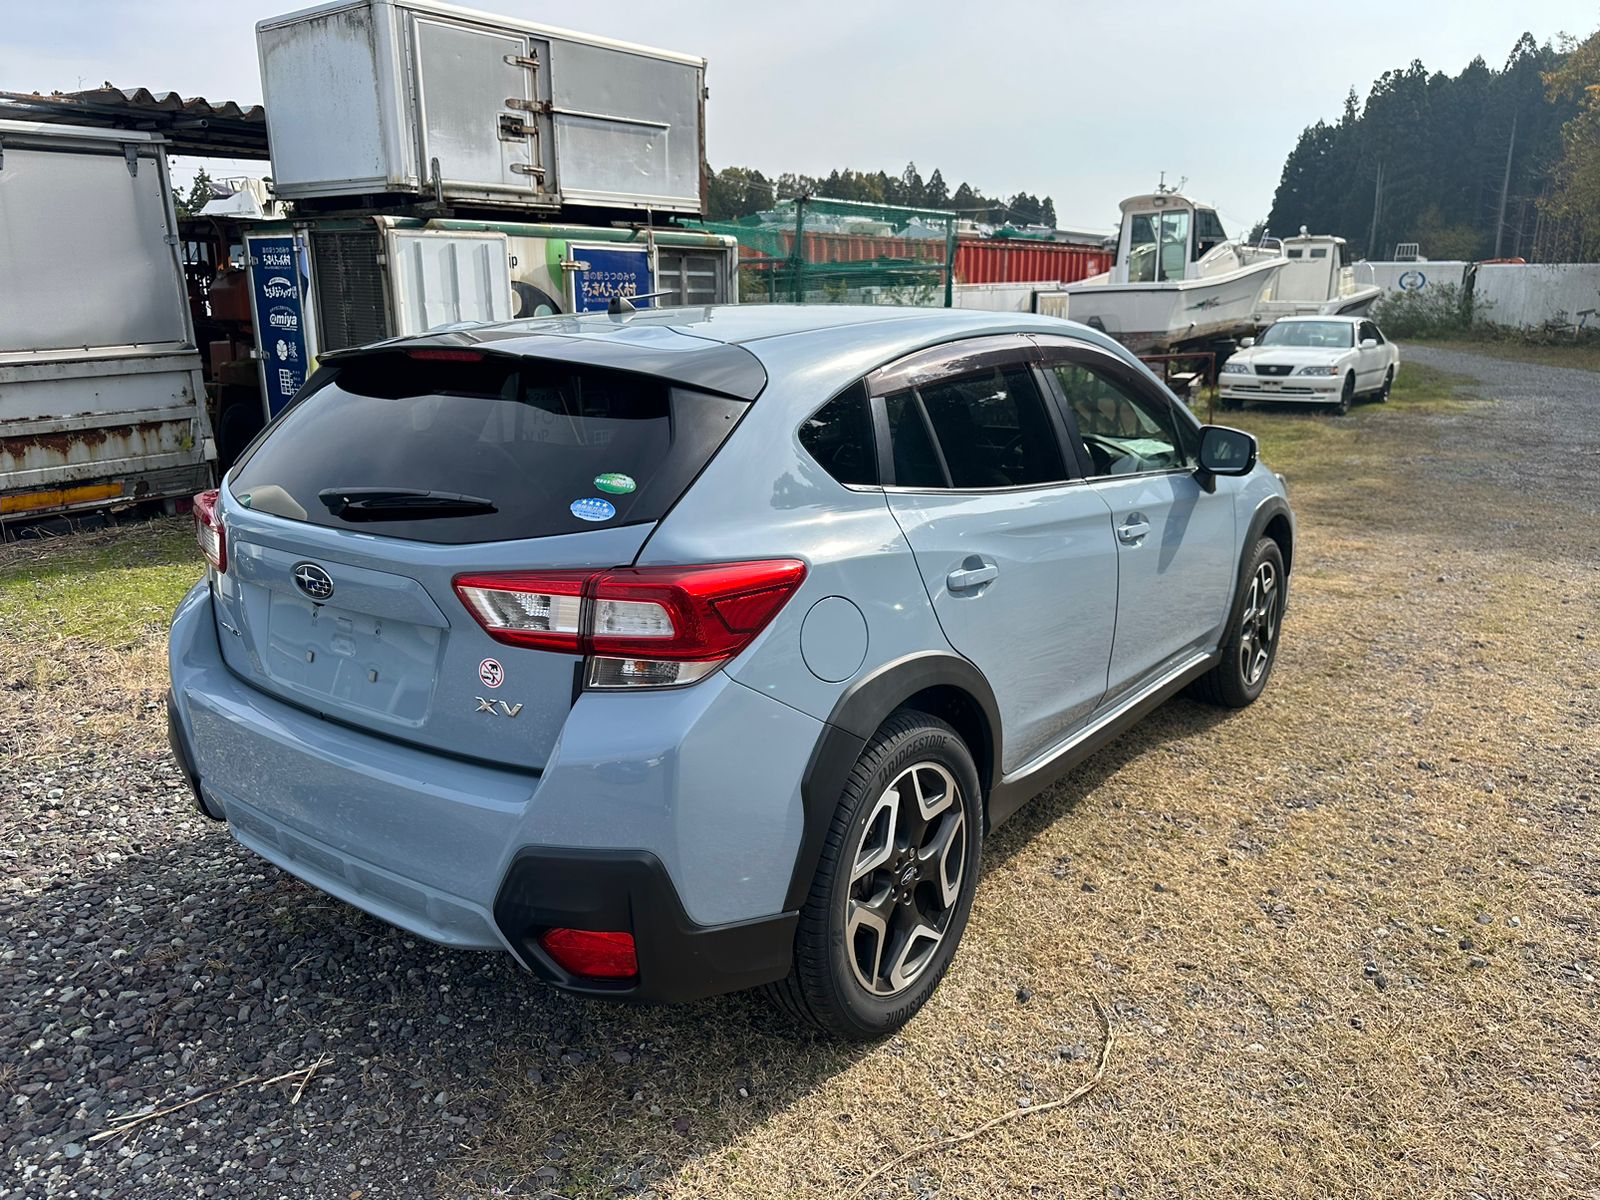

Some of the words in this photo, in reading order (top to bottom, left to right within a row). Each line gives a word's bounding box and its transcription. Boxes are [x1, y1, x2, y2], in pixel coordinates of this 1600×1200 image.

[583, 271, 637, 281] 道の駅うつのみや
[582, 281, 637, 297] ろまんちっく村
[270, 312, 297, 327] @miya
[475, 696, 523, 717] XV
[879, 735, 948, 789] BRIDGESTONE
